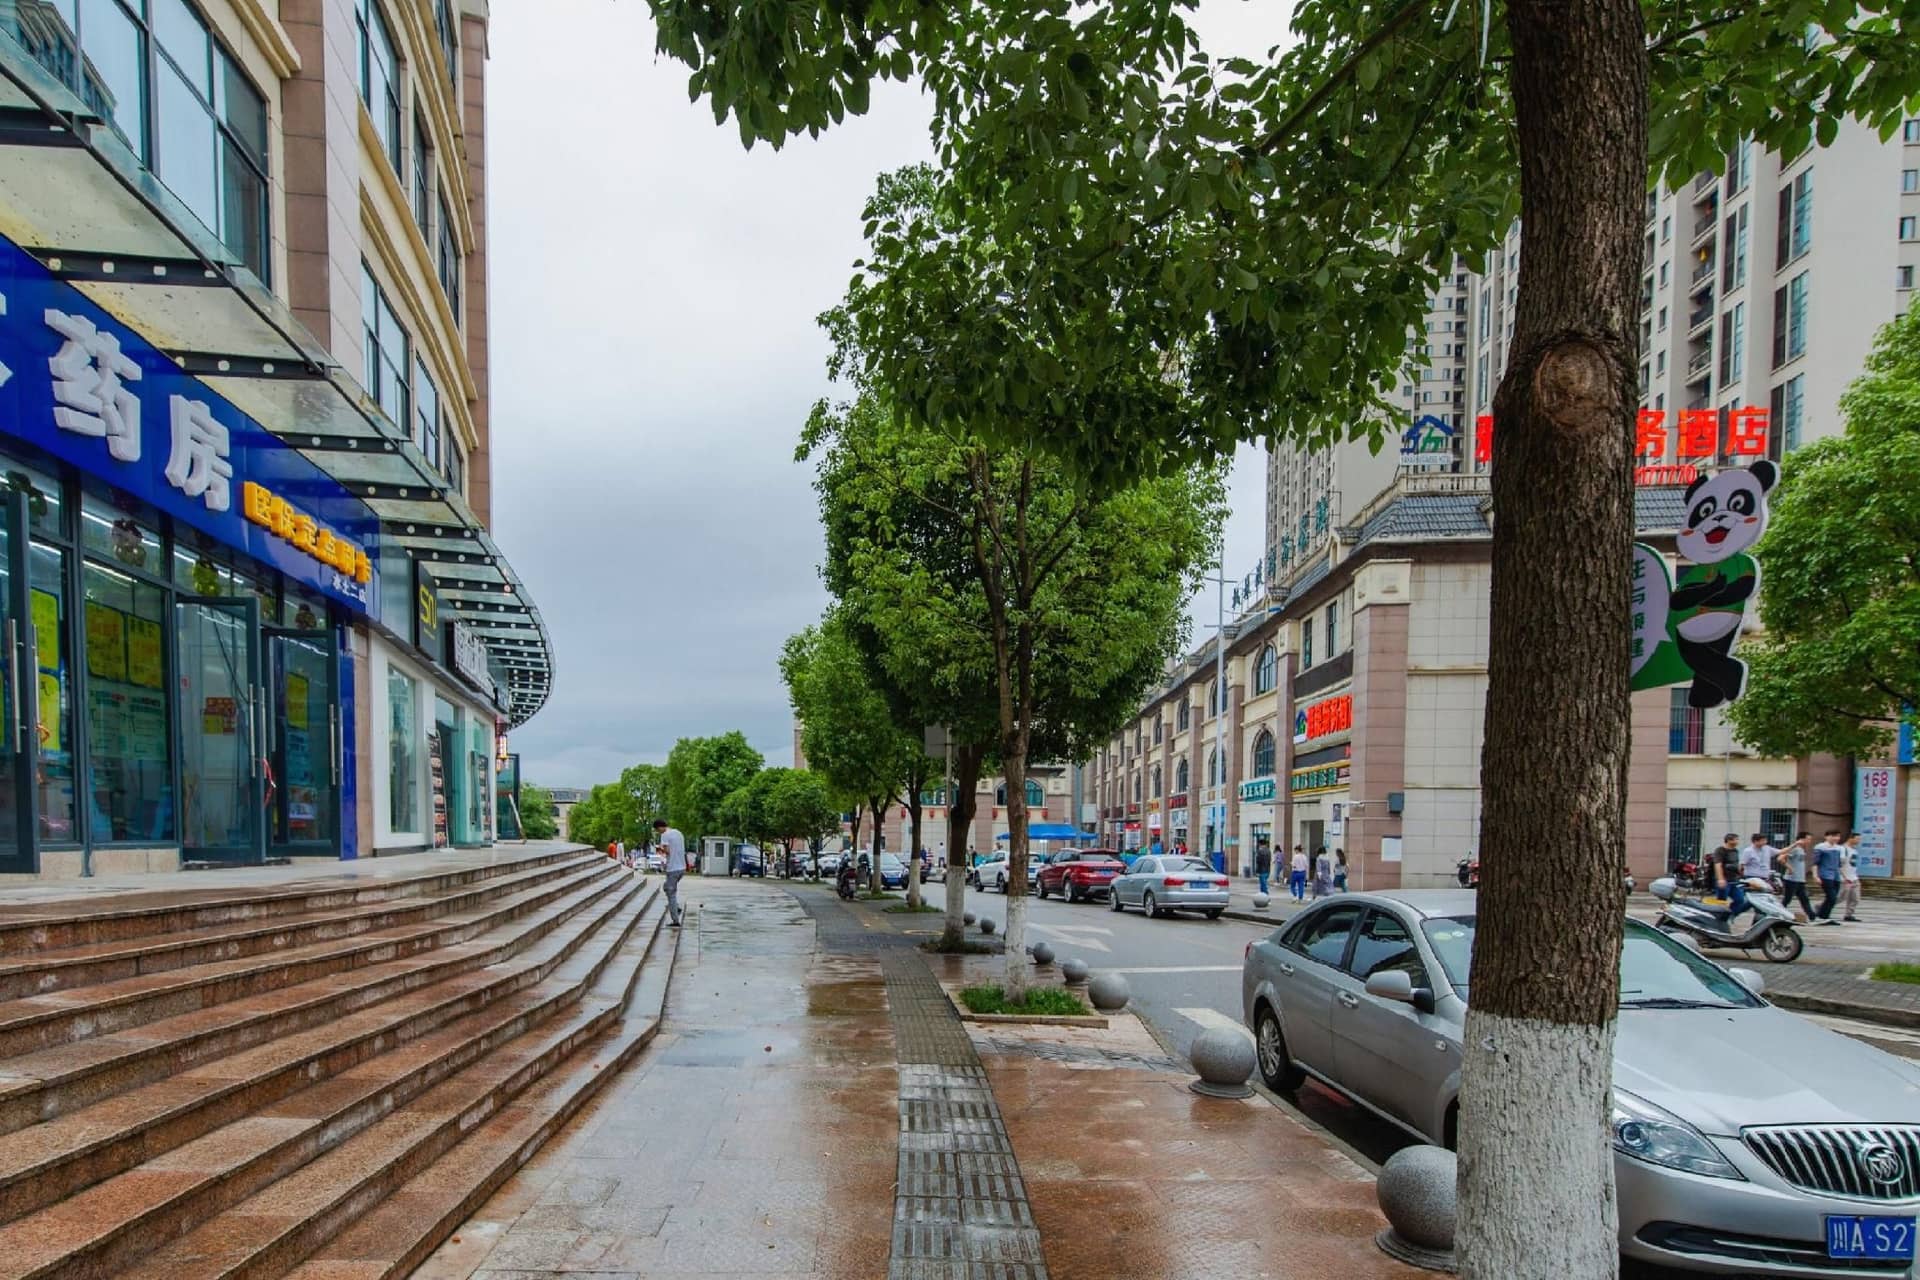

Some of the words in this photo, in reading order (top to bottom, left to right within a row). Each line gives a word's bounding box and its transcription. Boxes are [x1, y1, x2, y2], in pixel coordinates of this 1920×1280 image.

[0, 292, 233, 512] 药房
[1635, 405, 1769, 458] 务酒店
[243, 481, 372, 584] 医保定点刷卡
[1864, 772, 1888, 787] 168
